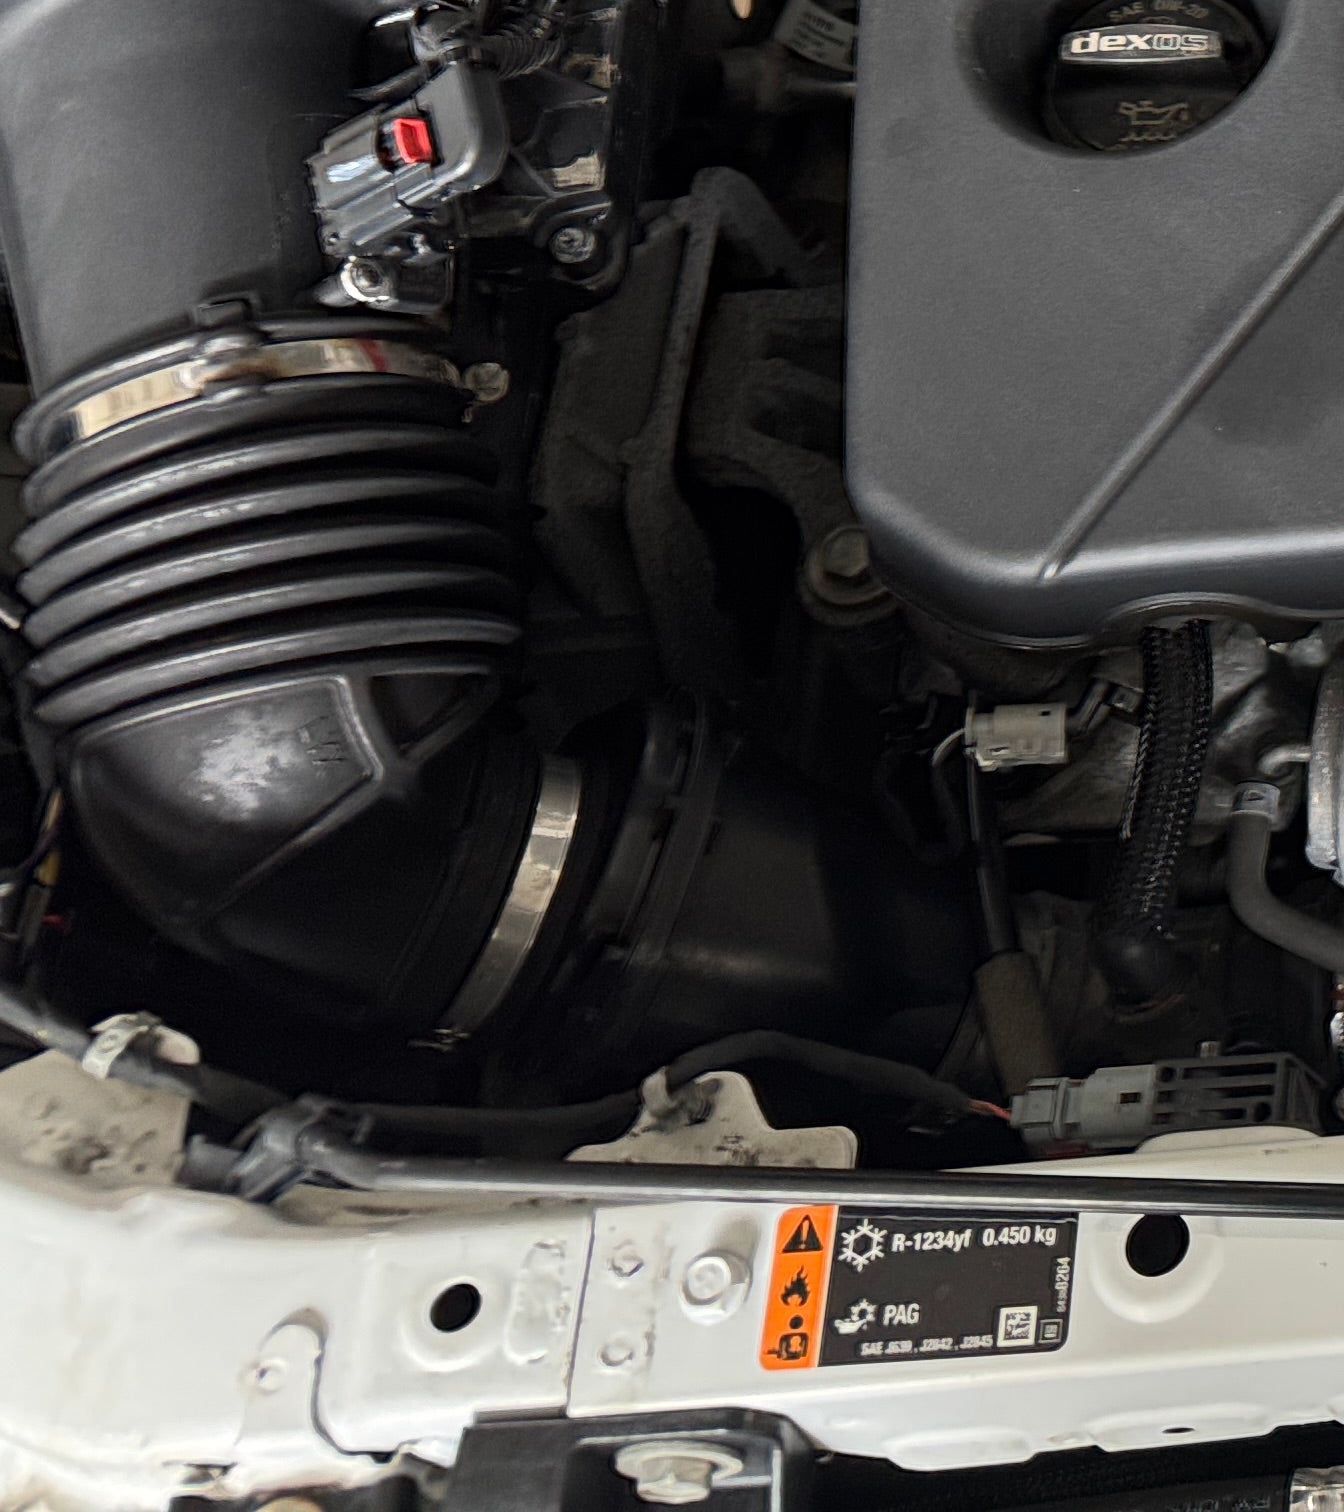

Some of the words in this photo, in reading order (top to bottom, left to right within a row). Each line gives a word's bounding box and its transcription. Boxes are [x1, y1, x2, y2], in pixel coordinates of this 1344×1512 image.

[1070, 31, 1209, 54] dexos
[891, 1229, 973, 1253] R-1234yf
[982, 1226, 1031, 1247] 0.450
[1034, 1225, 1058, 1246] kg
[882, 1303, 920, 1326] PAG
